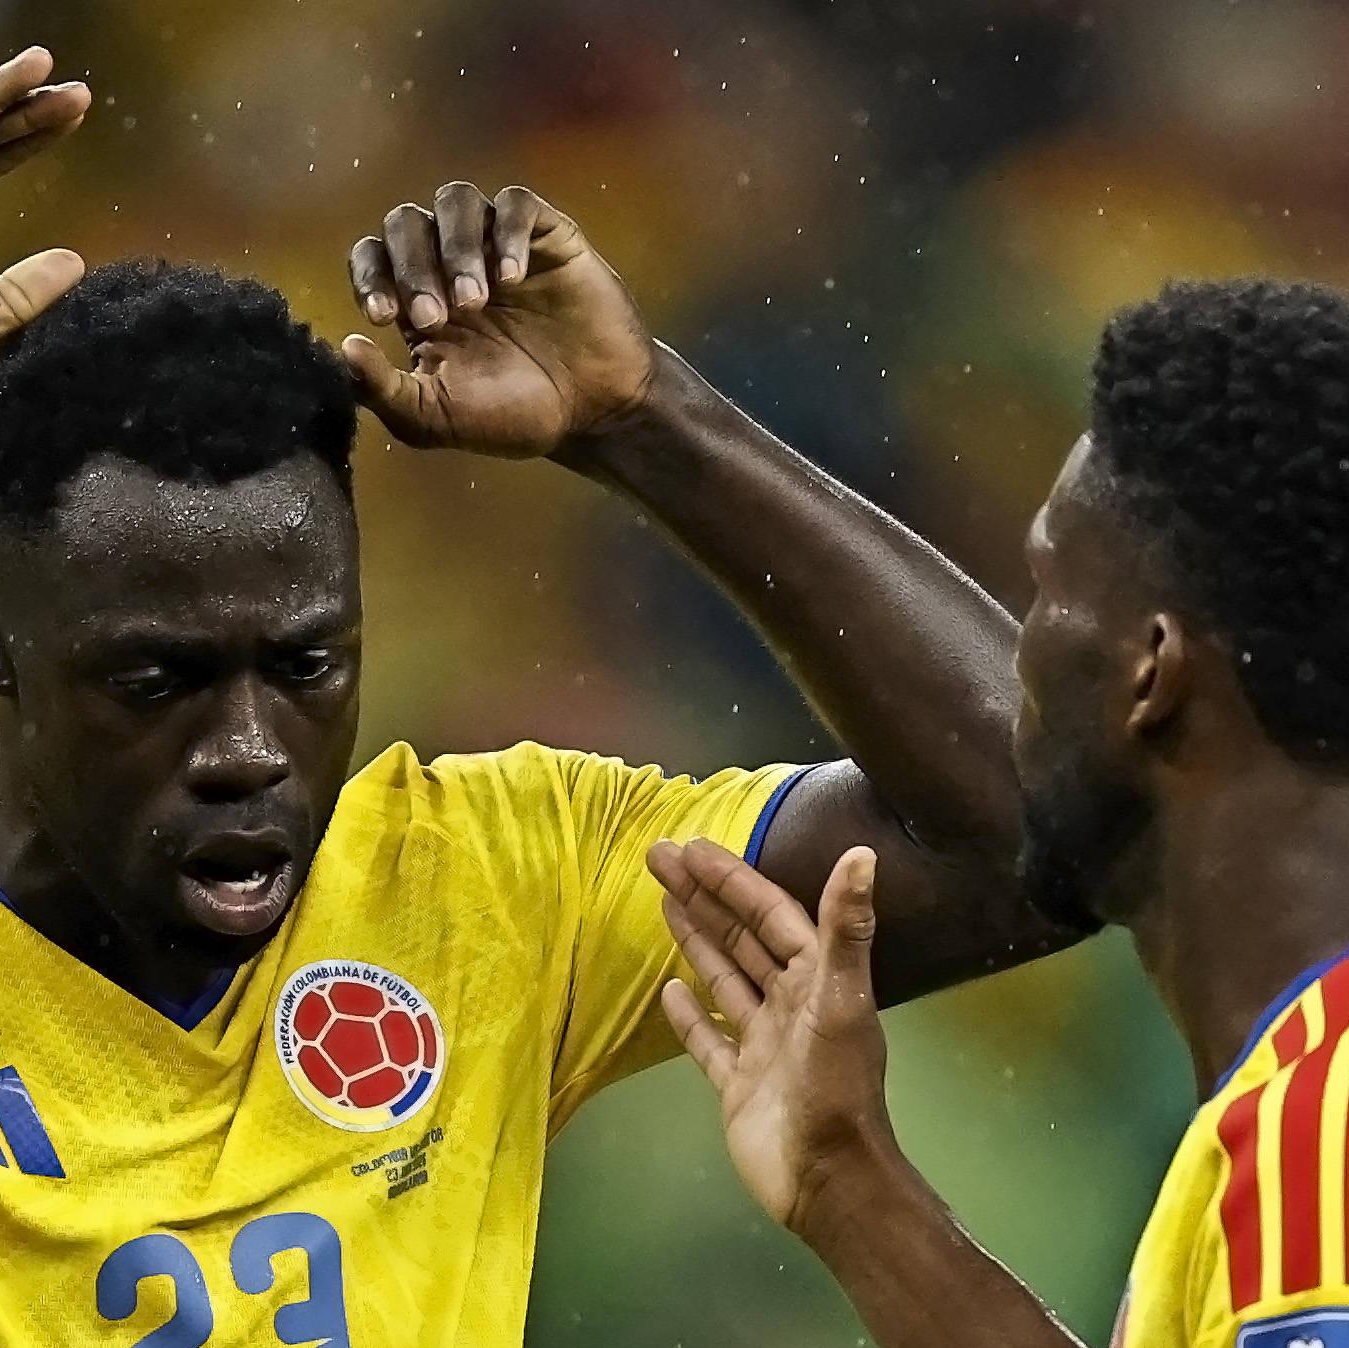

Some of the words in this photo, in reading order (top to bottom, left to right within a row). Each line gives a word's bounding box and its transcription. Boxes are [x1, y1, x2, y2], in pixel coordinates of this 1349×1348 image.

[292, 966, 360, 994] COLOMBIANA
[363, 969, 380, 983] DE
[379, 975, 423, 1014] FÚTBOL
